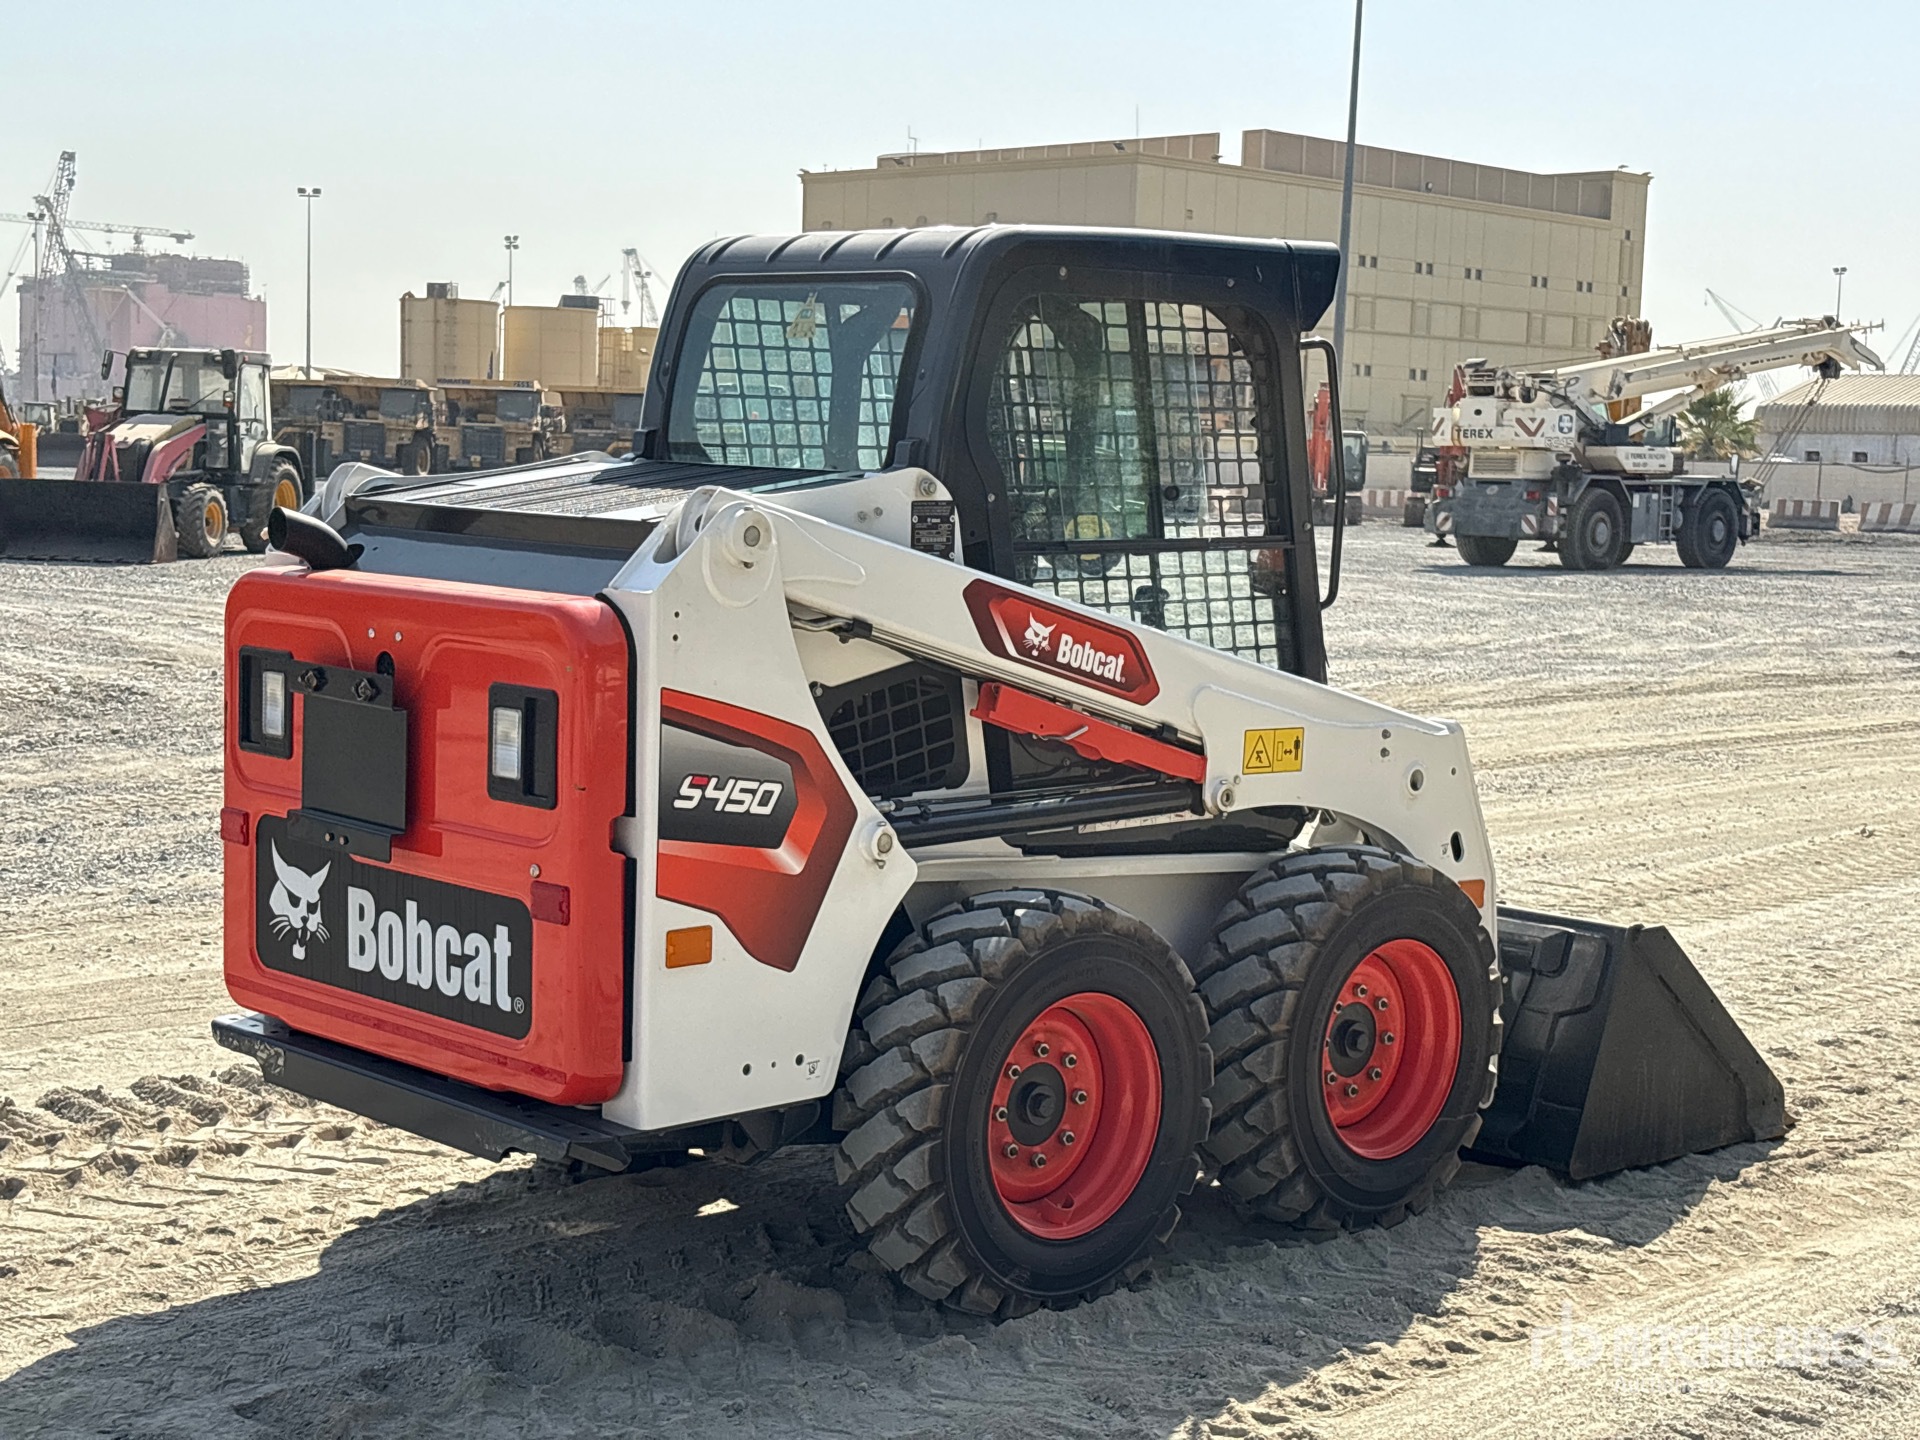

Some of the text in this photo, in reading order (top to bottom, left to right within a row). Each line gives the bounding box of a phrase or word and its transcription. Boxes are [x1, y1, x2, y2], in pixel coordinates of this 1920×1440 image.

[1455, 428, 1494, 439] TEREX
[1056, 633, 1125, 683] Bobcat
[673, 774, 783, 816] S450
[347, 886, 512, 1013] Bobcat
